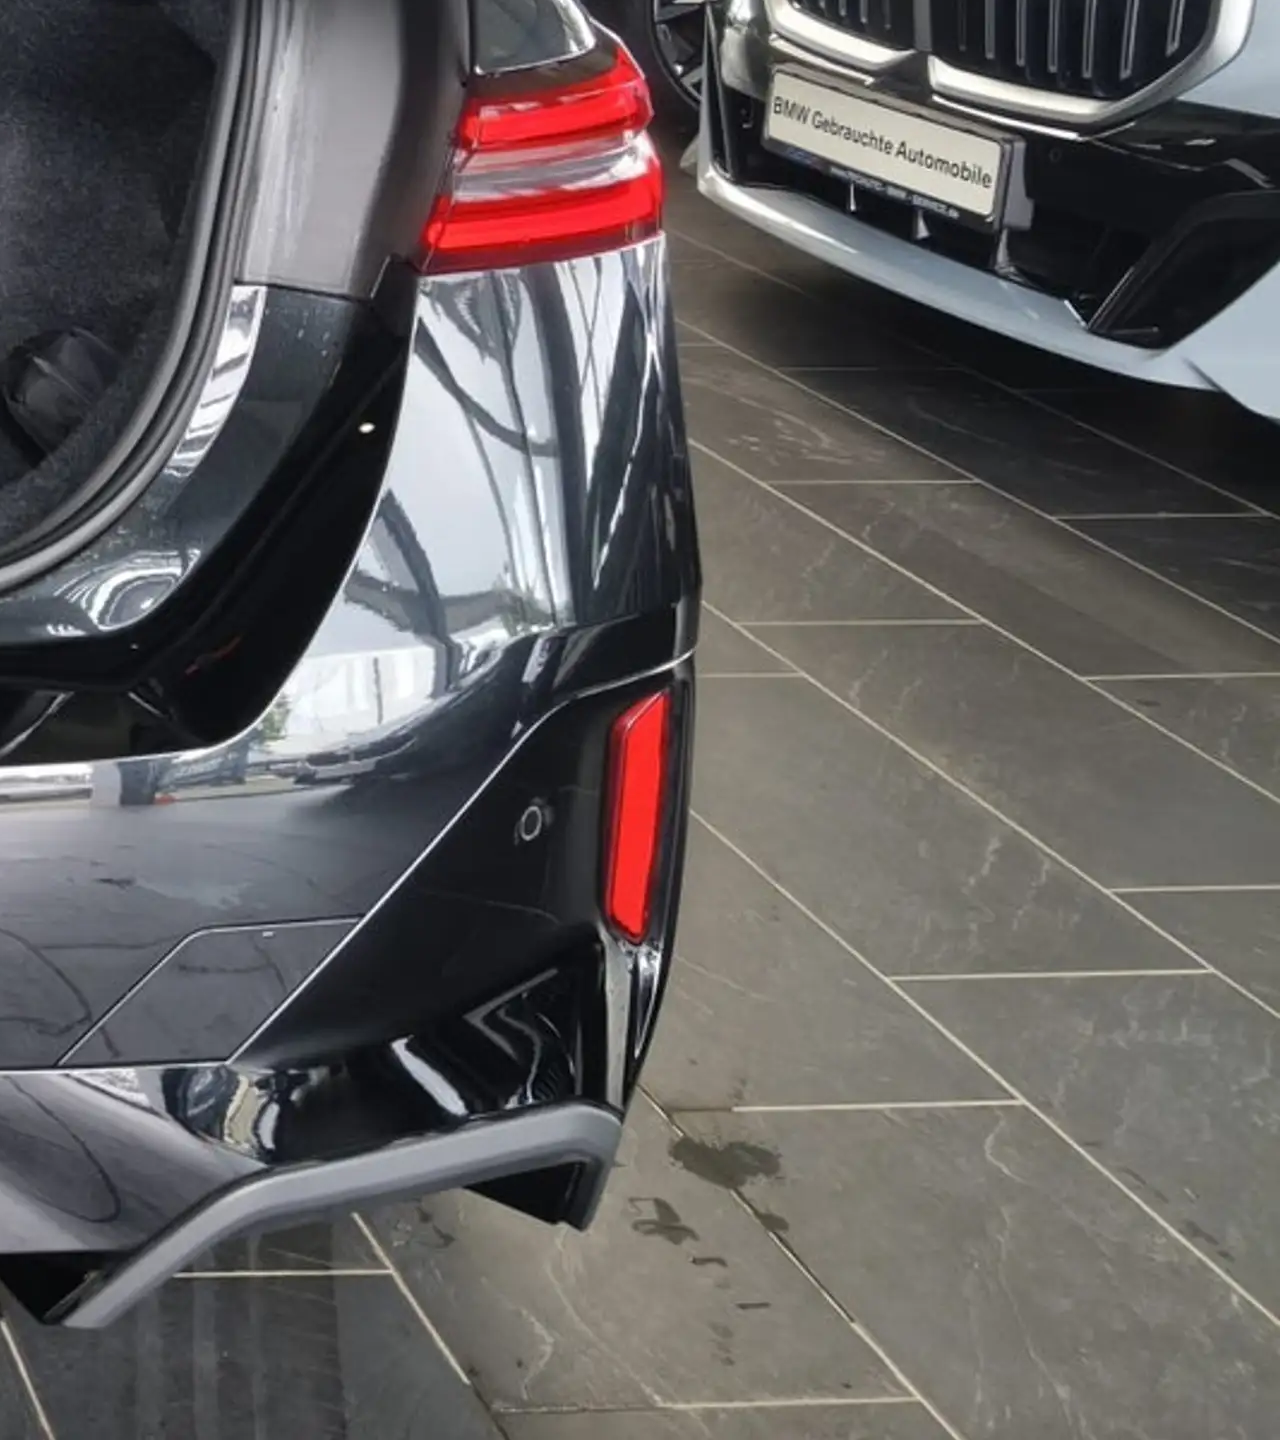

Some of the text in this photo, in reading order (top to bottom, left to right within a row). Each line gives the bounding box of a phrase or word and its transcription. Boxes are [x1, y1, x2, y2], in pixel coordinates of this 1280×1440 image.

[772, 96, 993, 189] BMW Gebrauchte Automobile
